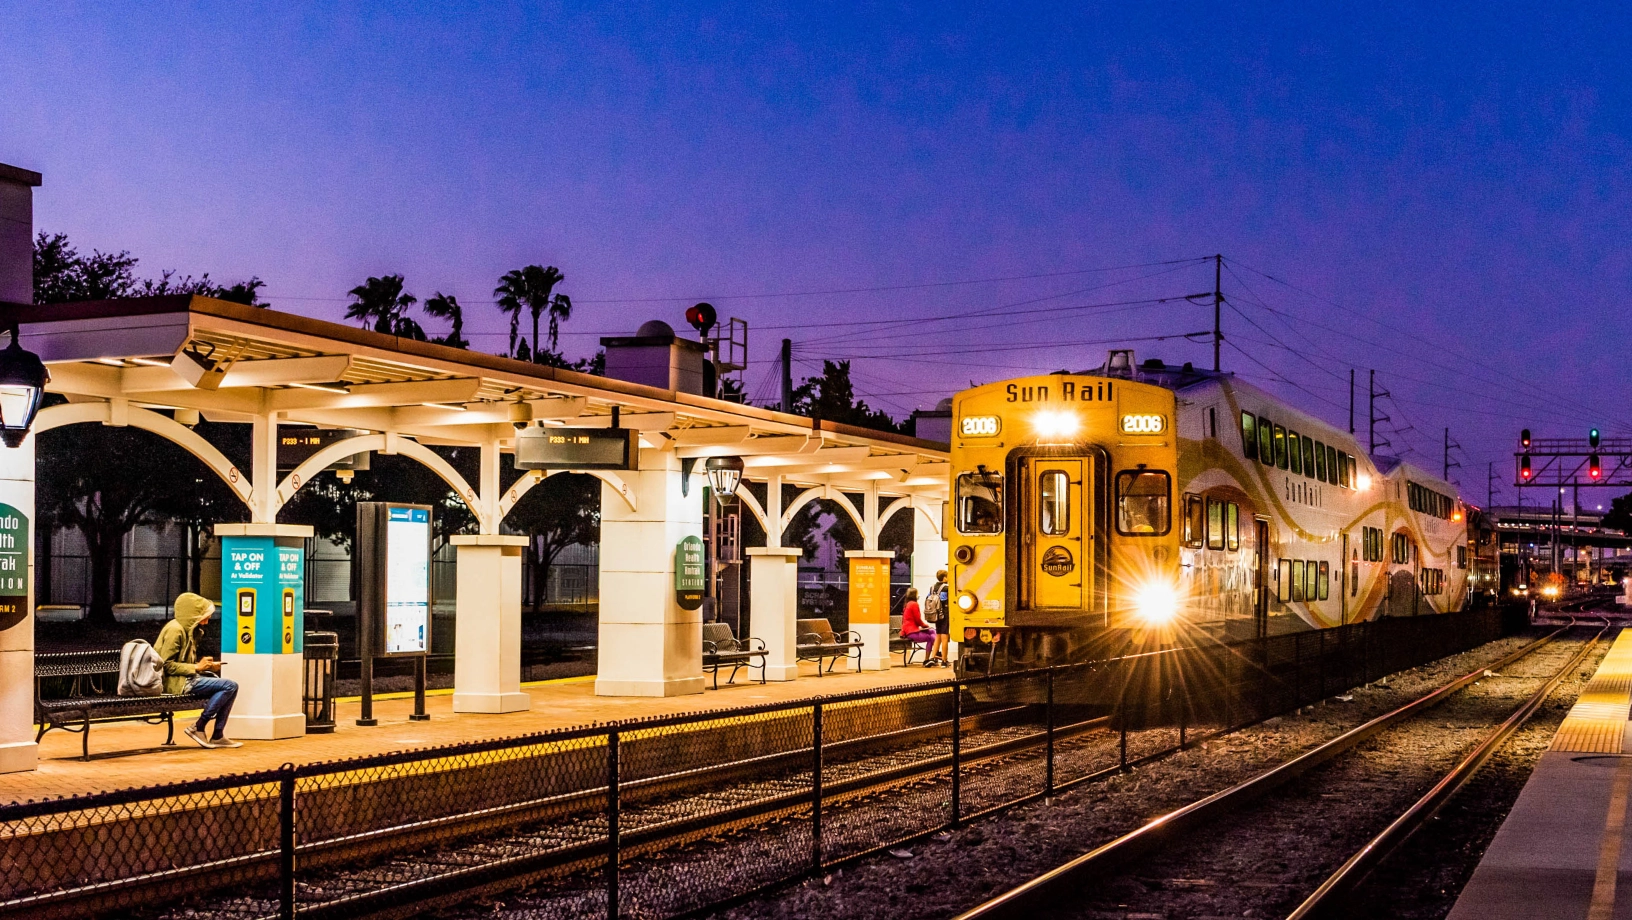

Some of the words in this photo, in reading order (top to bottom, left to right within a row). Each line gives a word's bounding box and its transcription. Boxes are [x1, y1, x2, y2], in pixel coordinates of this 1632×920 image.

[1006, 383, 1049, 402] Sun
[1063, 382, 1113, 402] Rail
[962, 417, 997, 434] 2006
[1124, 415, 1162, 432] 2006
[683, 541, 701, 552] Orlando
[231, 552, 247, 561] TAP
[249, 552, 264, 561] ON
[685, 553, 700, 562] Health
[0, 556, 16, 571] ak
[234, 562, 241, 570] &
[244, 562, 260, 570] OFF
[11, 605, 16, 613] 2
